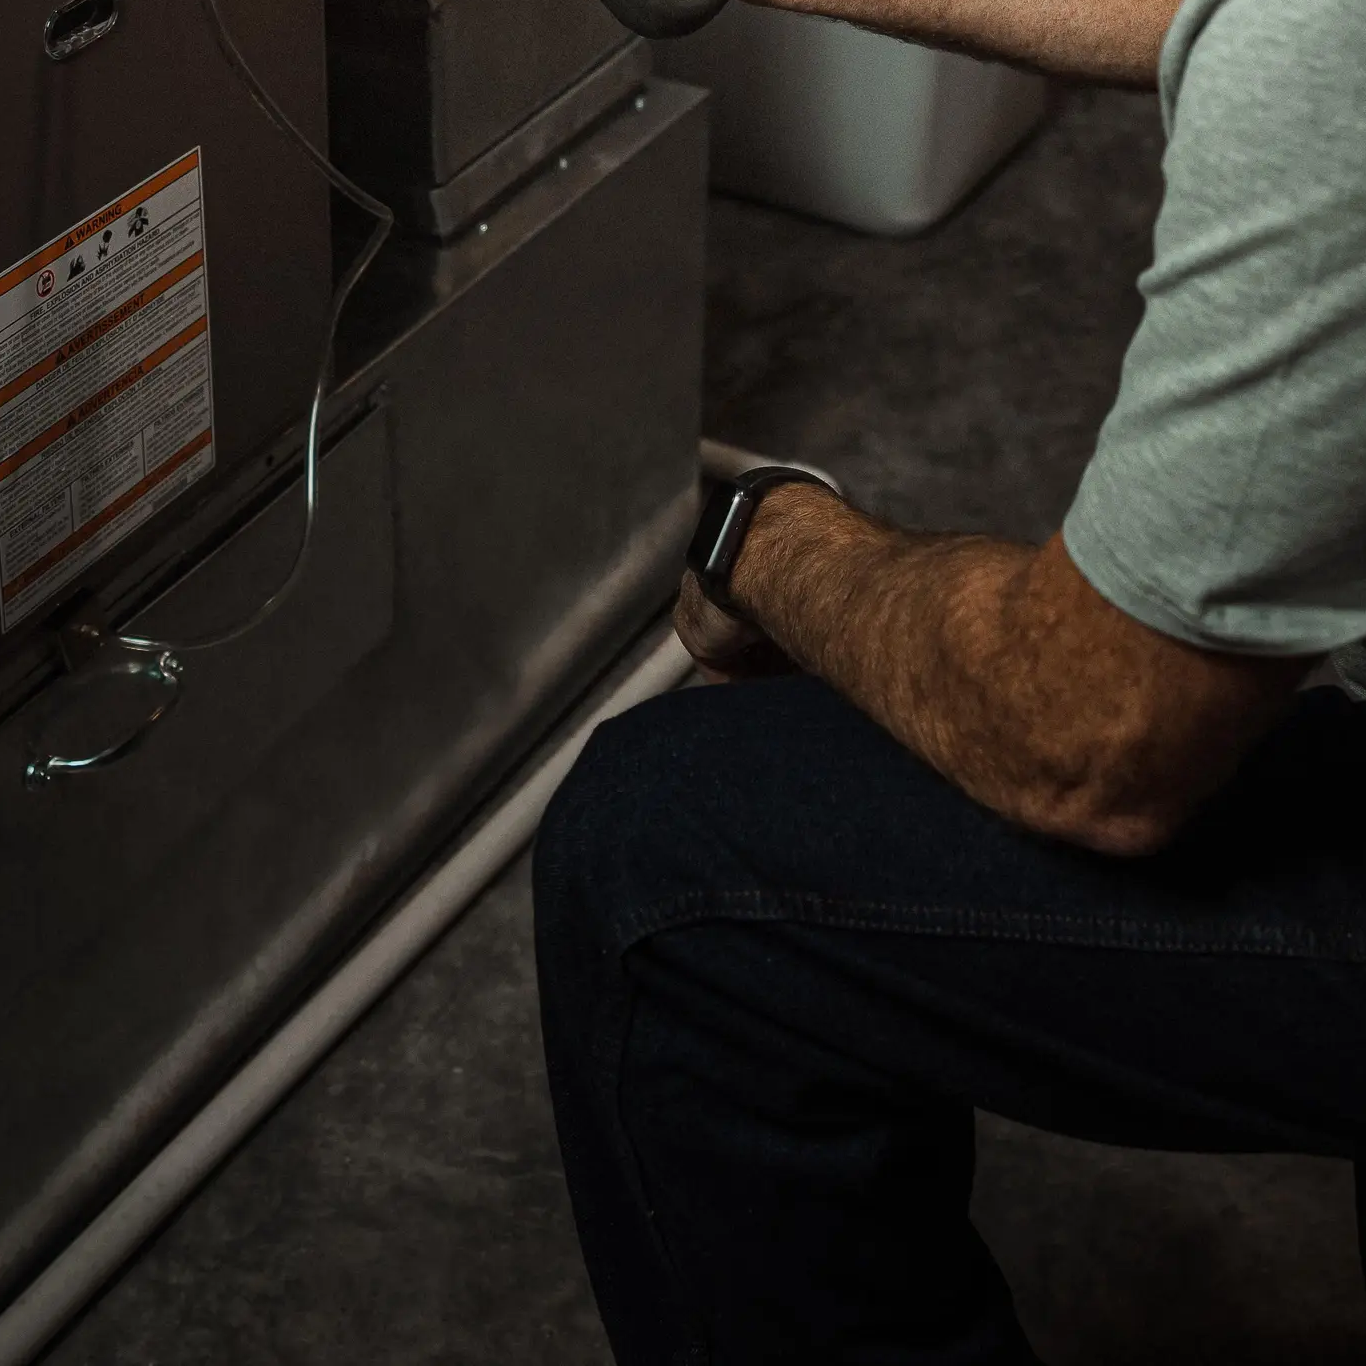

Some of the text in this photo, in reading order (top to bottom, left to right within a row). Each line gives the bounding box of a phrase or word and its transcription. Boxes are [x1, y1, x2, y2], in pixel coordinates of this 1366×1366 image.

[76, 203, 121, 242] WARNING
[45, 281, 79, 309] EXPLOSION
[81, 272, 93, 286] AND
[94, 243, 135, 277] ASPHYXIATION
[136, 227, 159, 248] HAZARD
[67, 292, 145, 356] AVERTISSEMENT
[36, 366, 62, 390] DANGER
[77, 363, 143, 421] ADVERTENCIA
